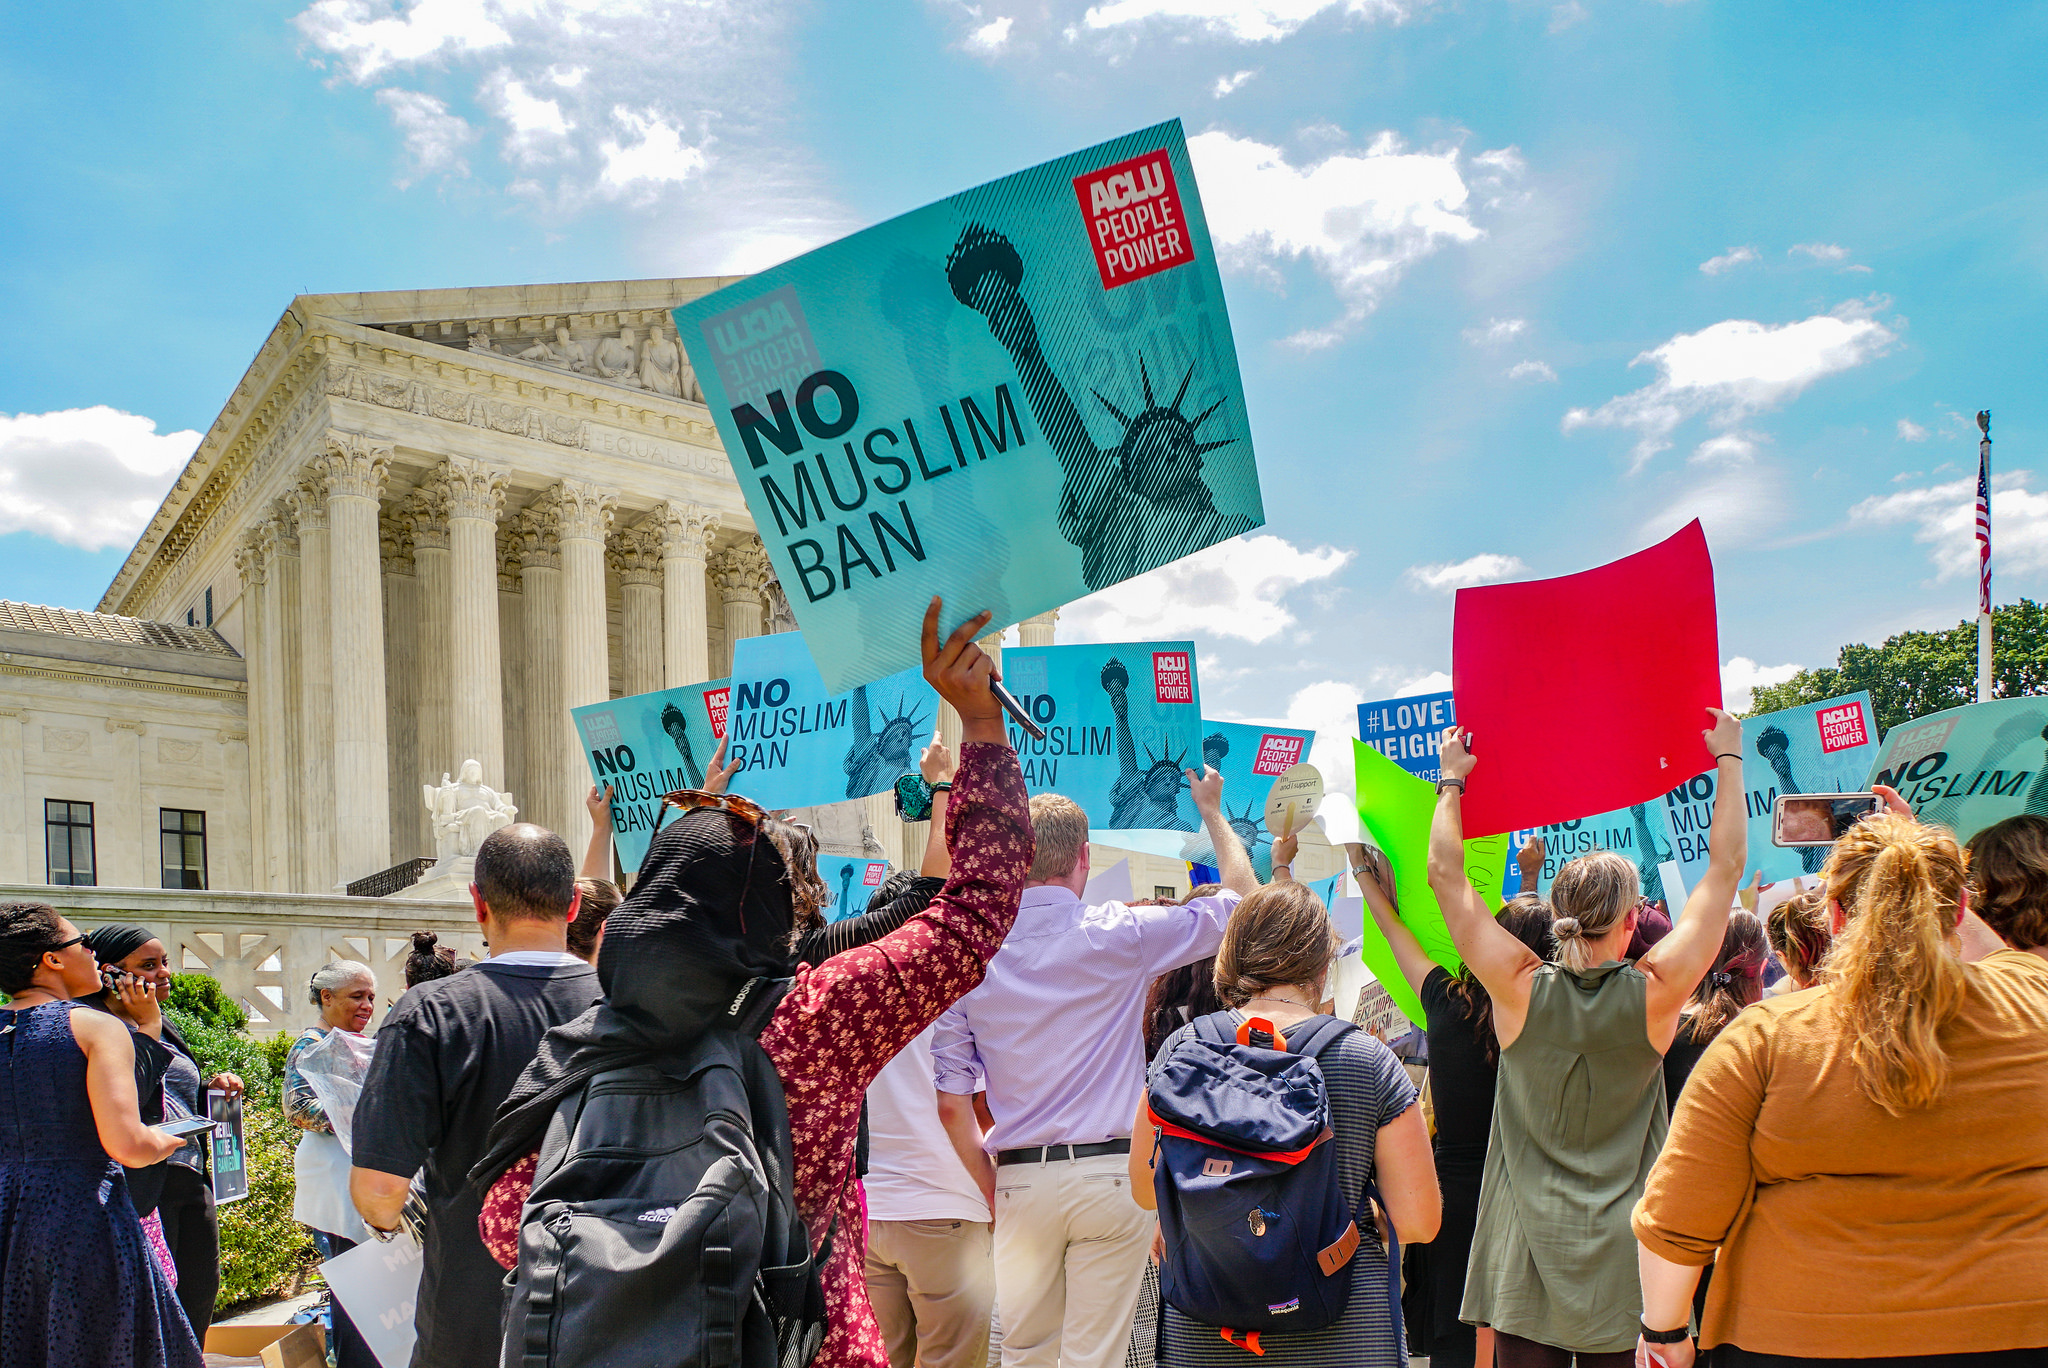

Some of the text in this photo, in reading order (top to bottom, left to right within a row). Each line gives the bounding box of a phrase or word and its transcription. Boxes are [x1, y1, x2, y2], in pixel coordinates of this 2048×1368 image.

[1090, 161, 1166, 217] ACLU
[1095, 196, 1176, 248] PEOPLE
[1104, 228, 1184, 278] POWER
[730, 369, 860, 469] NO
[604, 434, 676, 464] EQUAL
[758, 383, 1026, 537] MUSLIM
[785, 500, 928, 604] BAN
[1157, 656, 1186, 672] ACLU
[1158, 672, 1188, 686] PEOPLE
[736, 678, 790, 711] NO
[1159, 686, 1190, 700] POWER
[733, 699, 847, 741] MUSLIM
[1822, 706, 1858, 726] ACLU
[1823, 719, 1861, 738] PEOPLE
[1008, 726, 1111, 756] MUSLIM
[1264, 738, 1299, 752] ACLU
[1825, 731, 1864, 750] POWER
[592, 744, 635, 776] NO
[731, 740, 788, 773] BAN
[1260, 750, 1296, 763] PEOPLE
[1874, 751, 1948, 789] NO
[602, 767, 687, 805] MUSLIM
[1023, 758, 1058, 787] AN
[1280, 783, 1290, 791] and
[1294, 780, 1316, 790] support
[1898, 770, 2030, 804] SLIM
[1666, 774, 1714, 807] NO
[612, 803, 656, 834] BAN
[1670, 786, 1777, 836] MUIM
[1543, 826, 1632, 856] MUSLIM
[1677, 833, 1710, 864] BA
[1543, 856, 1573, 880] BA
